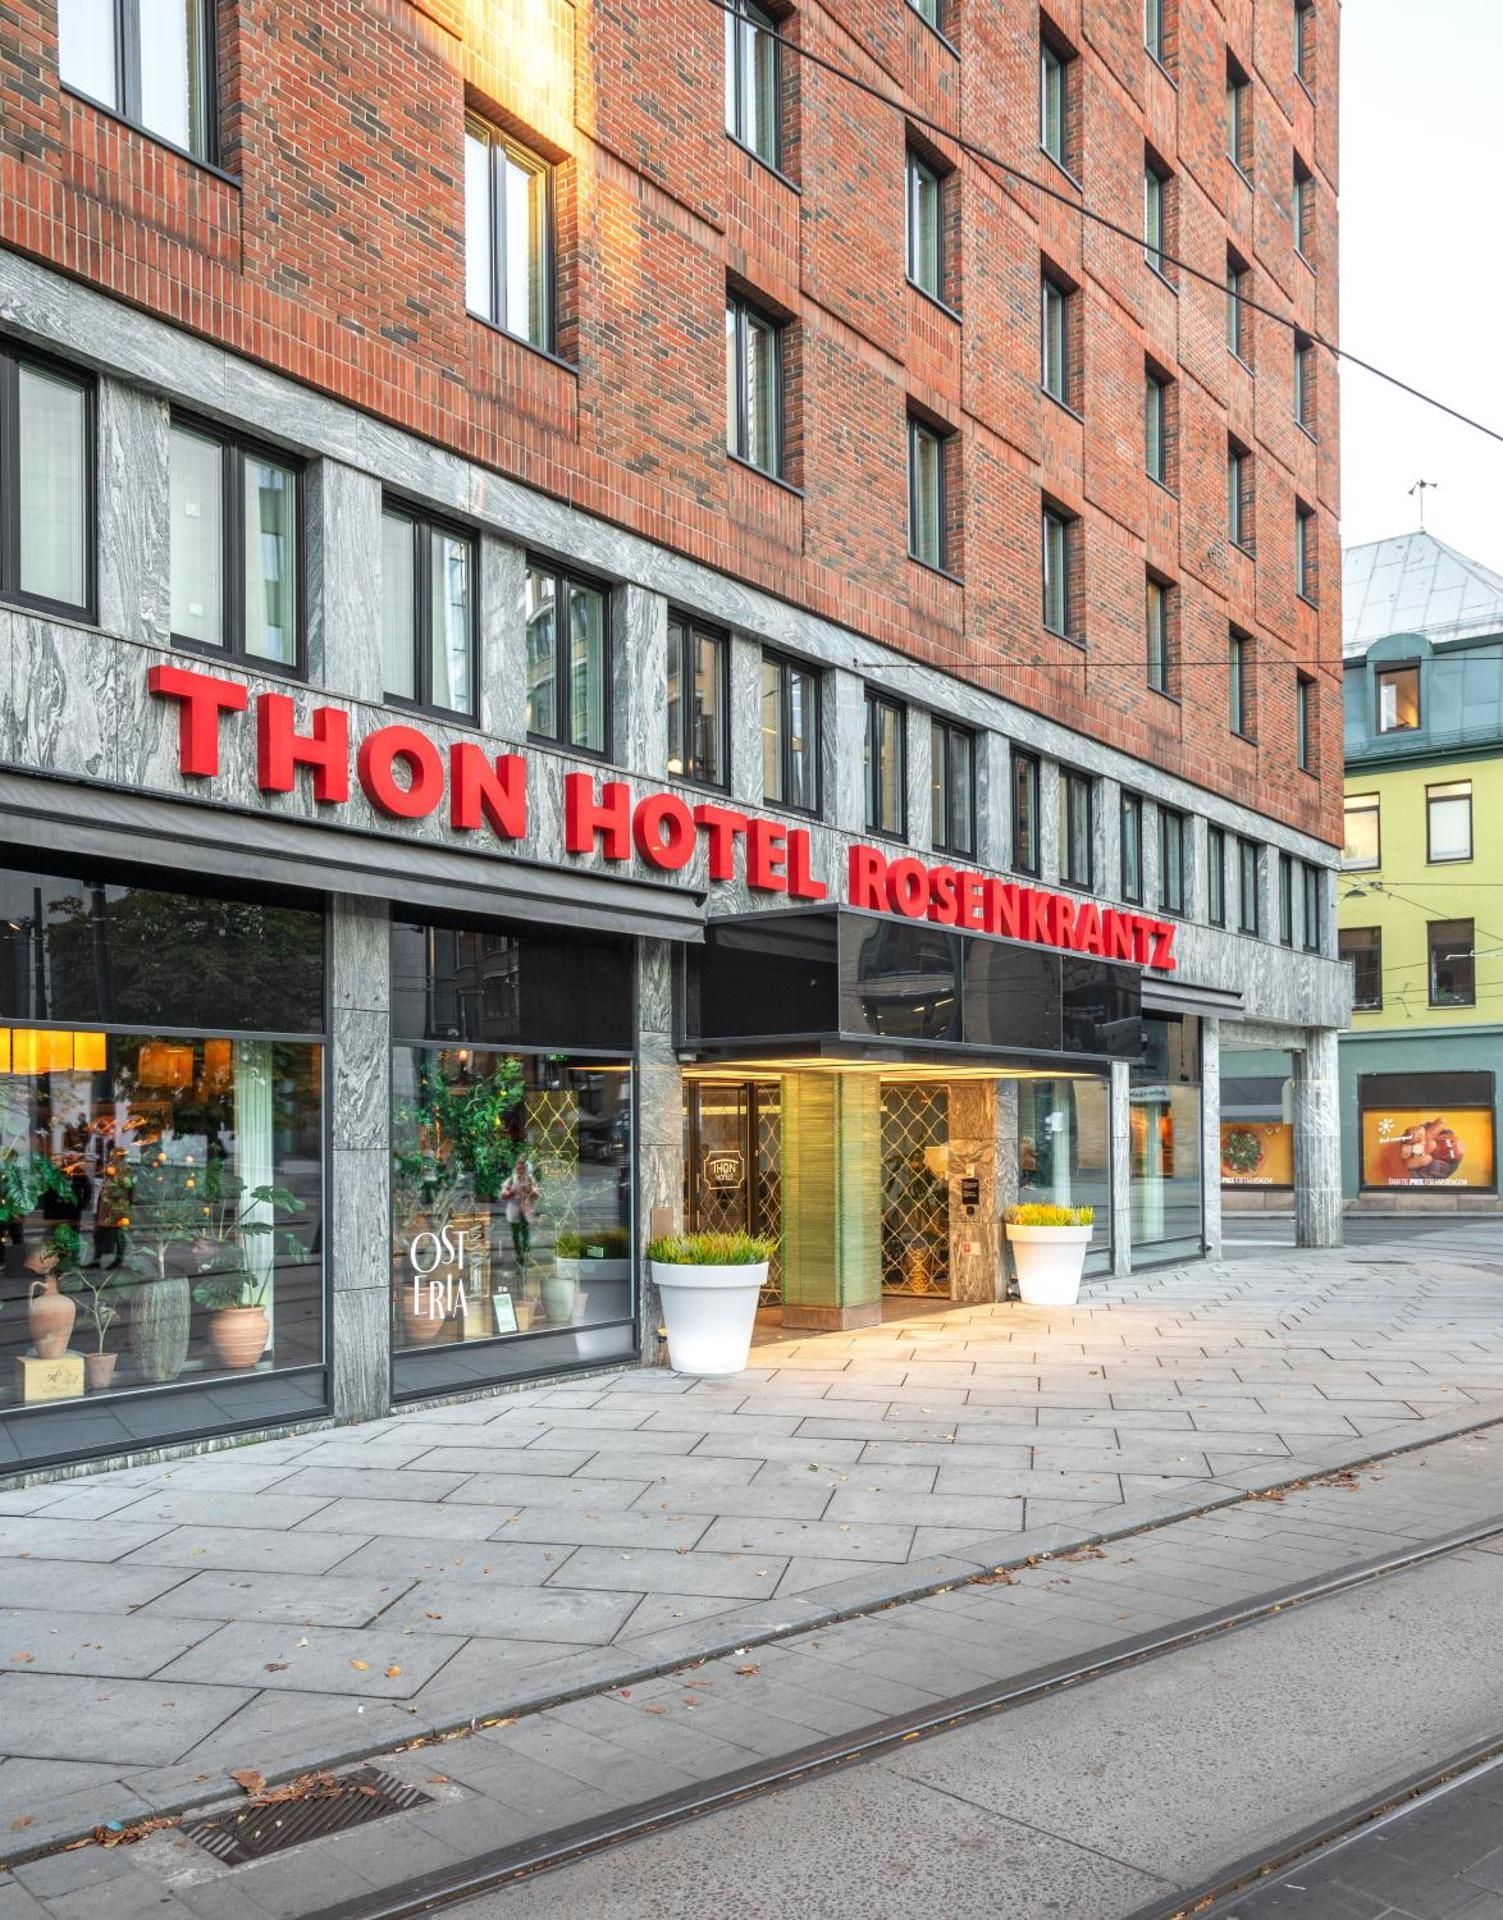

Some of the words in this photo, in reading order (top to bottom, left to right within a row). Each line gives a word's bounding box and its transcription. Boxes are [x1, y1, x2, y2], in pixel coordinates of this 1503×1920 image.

[148, 664, 526, 839] THON
[565, 772, 827, 900] HOTEL
[848, 844, 1177, 971] ROSENKRANTZ
[711, 1159, 738, 1173] THON
[411, 1225, 469, 1273] OST
[414, 1274, 468, 1320] ERIA
